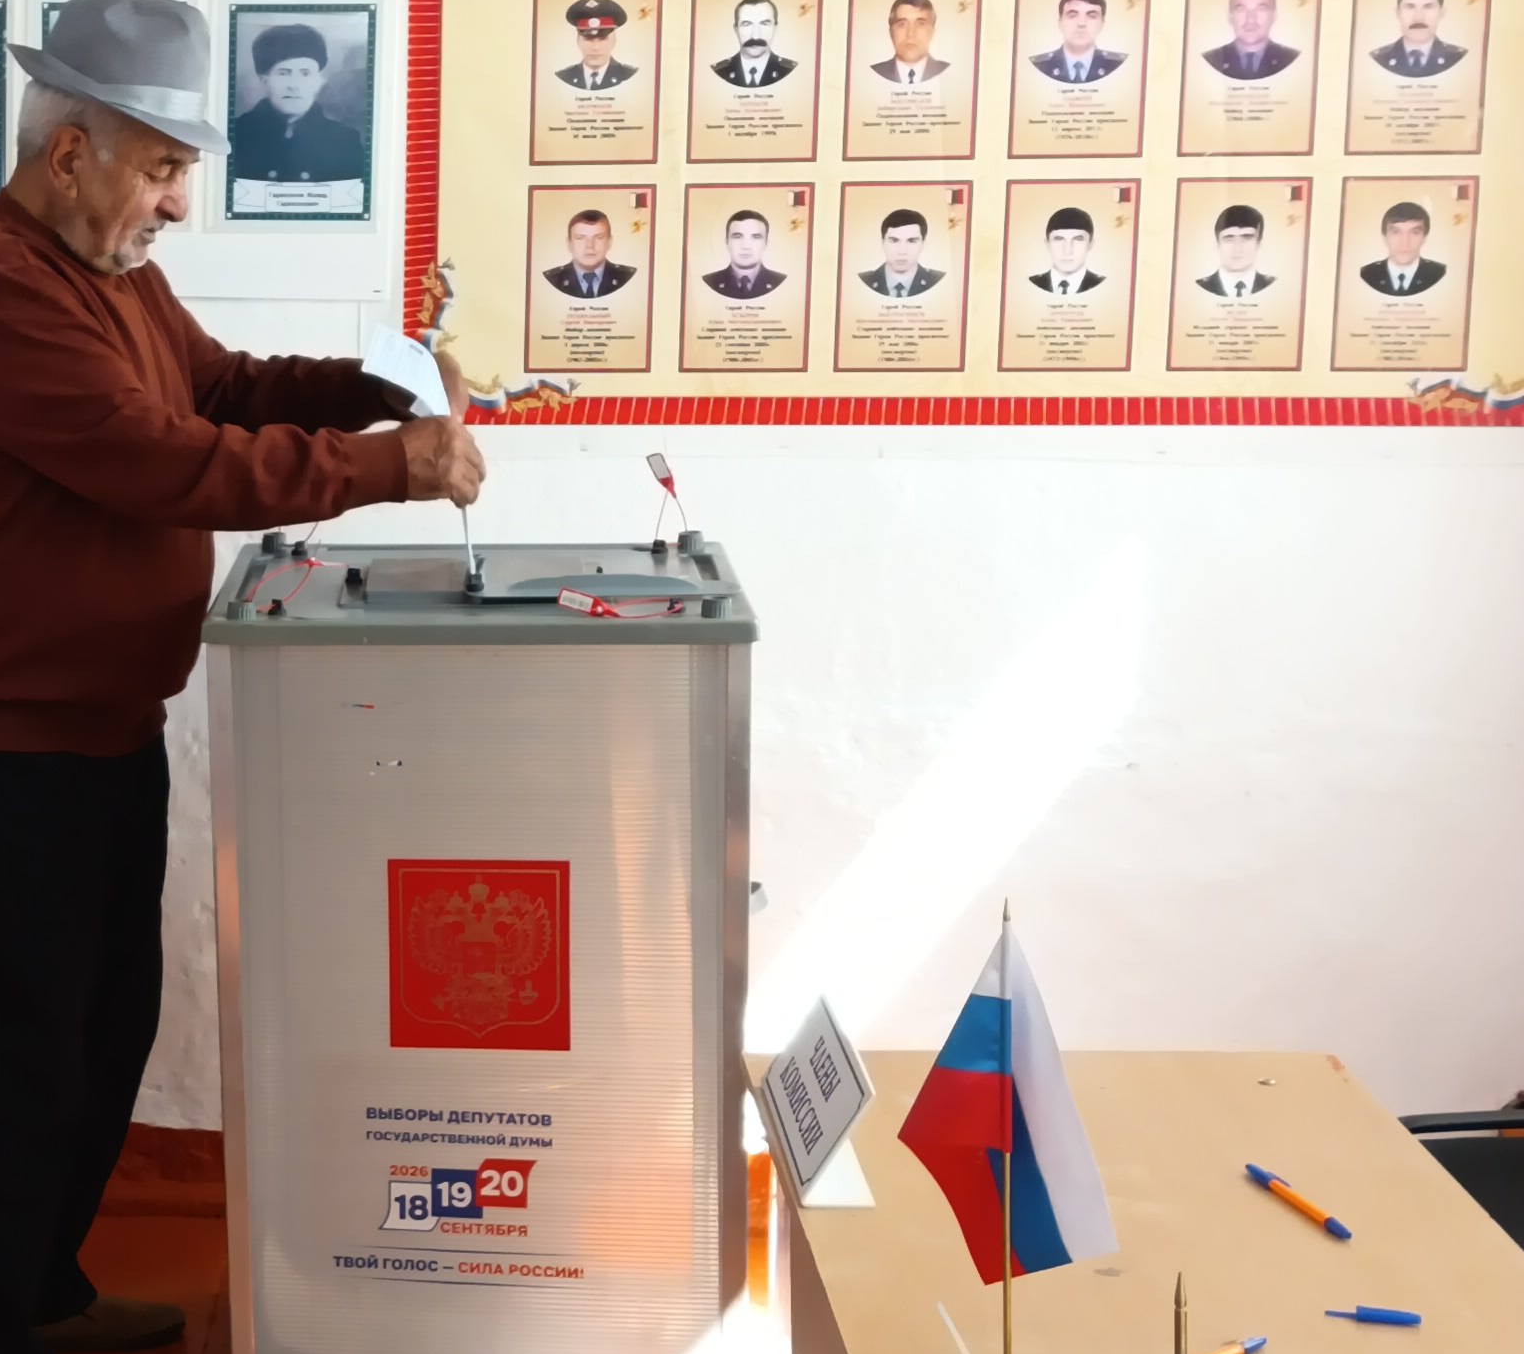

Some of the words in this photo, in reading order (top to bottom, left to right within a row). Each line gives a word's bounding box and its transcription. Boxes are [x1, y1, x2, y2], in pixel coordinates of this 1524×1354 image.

[809, 1035, 841, 1103] ЧЛЕНЫ
[366, 1106, 444, 1122] ВЫБОРЫ
[447, 1110, 553, 1127] ДЕПУТАТОВ
[780, 1056, 824, 1156] КОМИССИИ
[366, 1130, 506, 1146] ГОСУДАРСТВЕННОЙ
[509, 1136, 553, 1148] ДУМЫ
[389, 1165, 430, 1178] 2026
[394, 1194, 429, 1221] 18
[436, 1181, 473, 1209] 19
[480, 1169, 525, 1198] 20
[439, 1221, 529, 1238] СЕНТЯБРЯ
[333, 1254, 378, 1270] ТВОЙ
[382, 1258, 438, 1273] ГОЛОС
[458, 1262, 504, 1275] СИЛА
[508, 1264, 585, 1279] РОССИИ!
